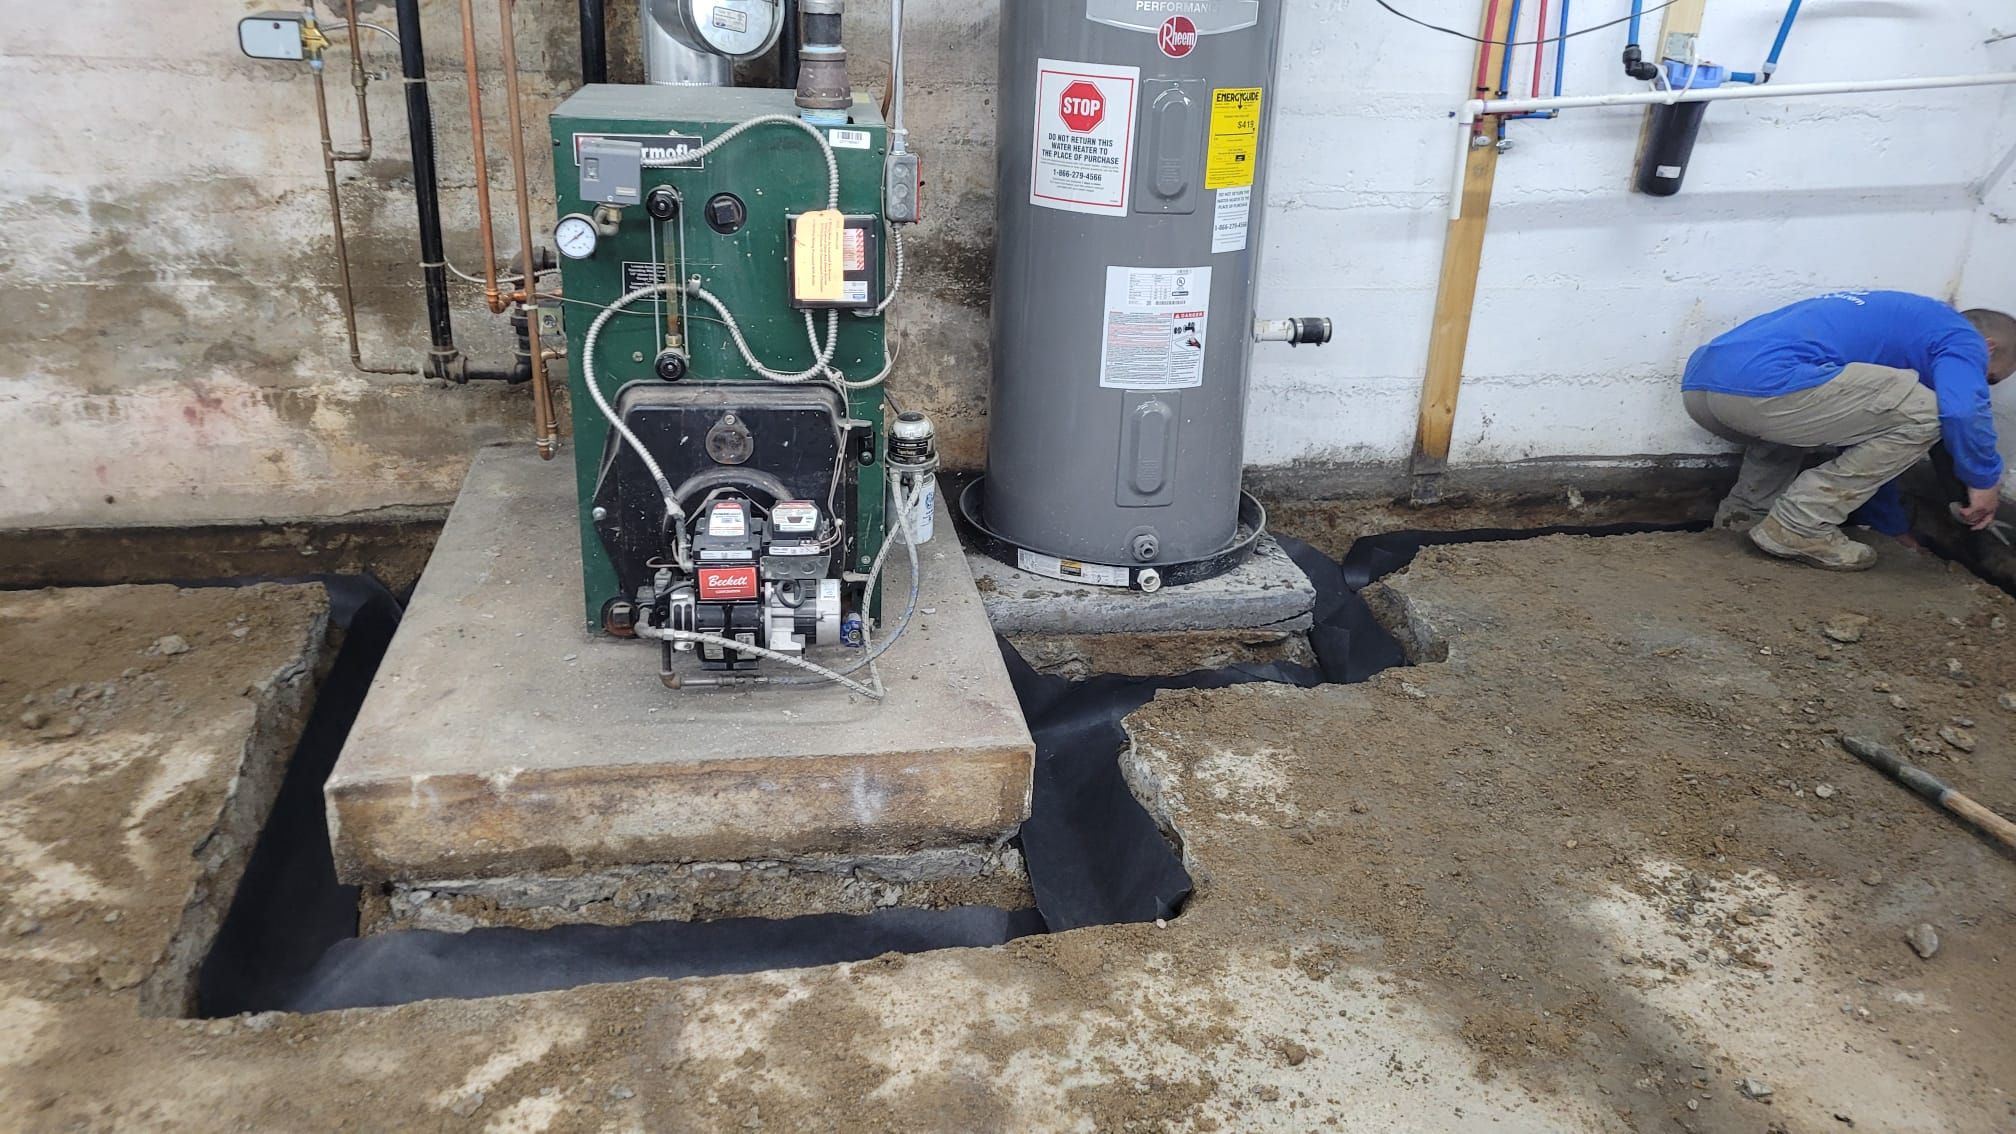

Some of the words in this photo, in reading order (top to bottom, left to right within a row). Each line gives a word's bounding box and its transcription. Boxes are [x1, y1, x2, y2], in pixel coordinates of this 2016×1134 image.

[1135, 1, 1217, 13] PERFORMAN
[1162, 16, 1195, 51] Rheem
[1063, 96, 1100, 117] STOP
[1048, 132, 1056, 141] DO
[1058, 134, 1069, 142] NOT
[1071, 135, 1096, 146] RETURN
[1098, 138, 1113, 147] THIS
[1051, 141, 1072, 151] WATER
[1073, 144, 1097, 154] HEATER
[1100, 147, 1108, 155] TO
[1042, 148, 1052, 157] THE
[1053, 150, 1072, 160] PLACE
[1074, 152, 1082, 161] OF
[1084, 154, 1119, 165] PURCHASE
[707, 574, 748, 587] Beckett
